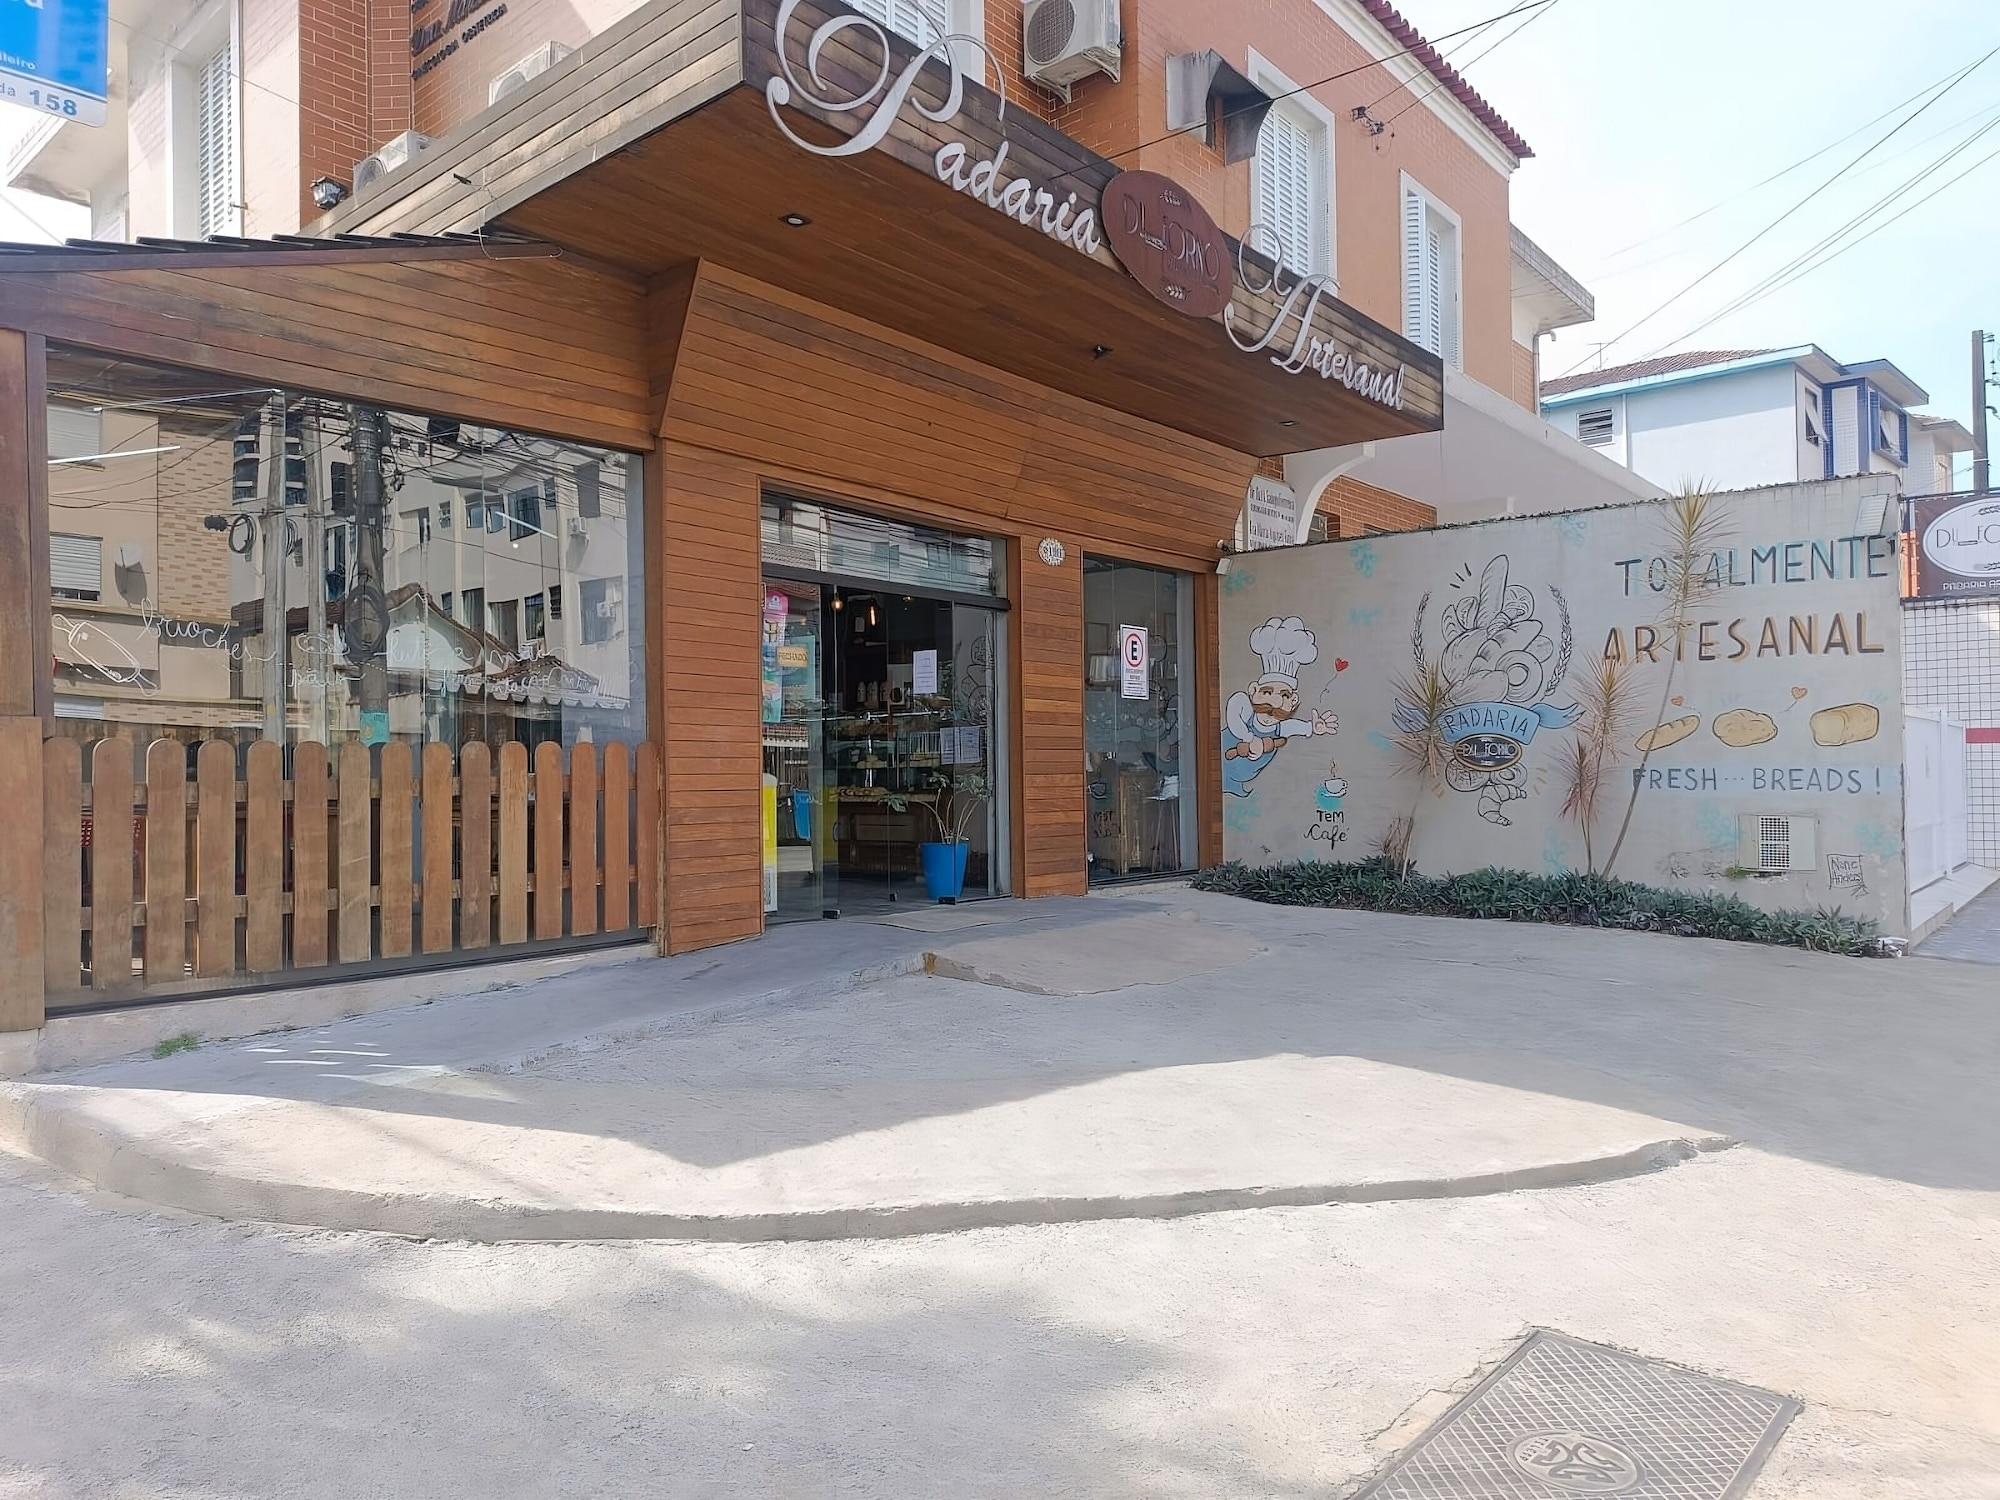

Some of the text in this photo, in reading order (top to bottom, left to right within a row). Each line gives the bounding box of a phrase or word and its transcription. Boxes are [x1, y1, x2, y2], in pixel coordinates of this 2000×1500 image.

[29, 89, 77, 116] 158
[766, 0, 1101, 254] Padaria
[1223, 223, 1406, 411] Artesanal
[1131, 639, 1138, 661] E
[1602, 611, 1886, 665] ARTESANAL
[1632, 767, 1717, 792] FRESH
[1303, 823, 1350, 850] Café
